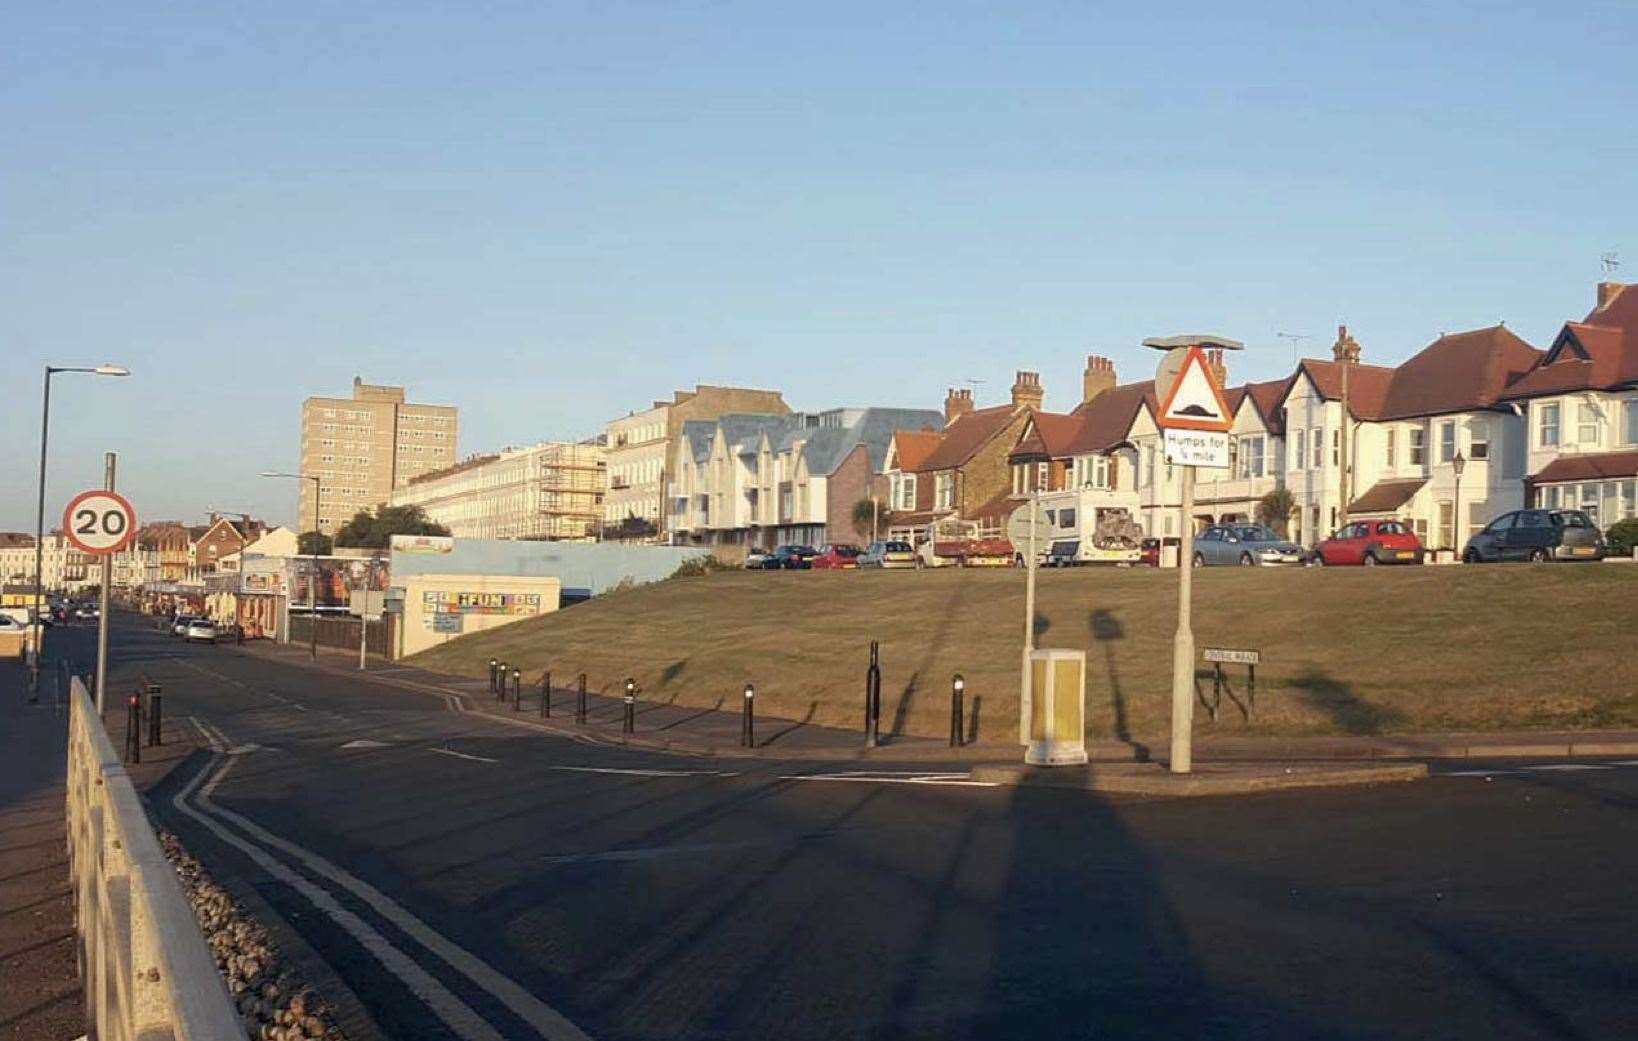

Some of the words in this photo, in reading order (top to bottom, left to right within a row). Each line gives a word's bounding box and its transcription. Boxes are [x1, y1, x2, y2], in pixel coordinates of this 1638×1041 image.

[1168, 433, 1205, 448] Humps
[1209, 436, 1225, 448] for
[1193, 451, 1215, 461] mile
[76, 509, 126, 535] 20
